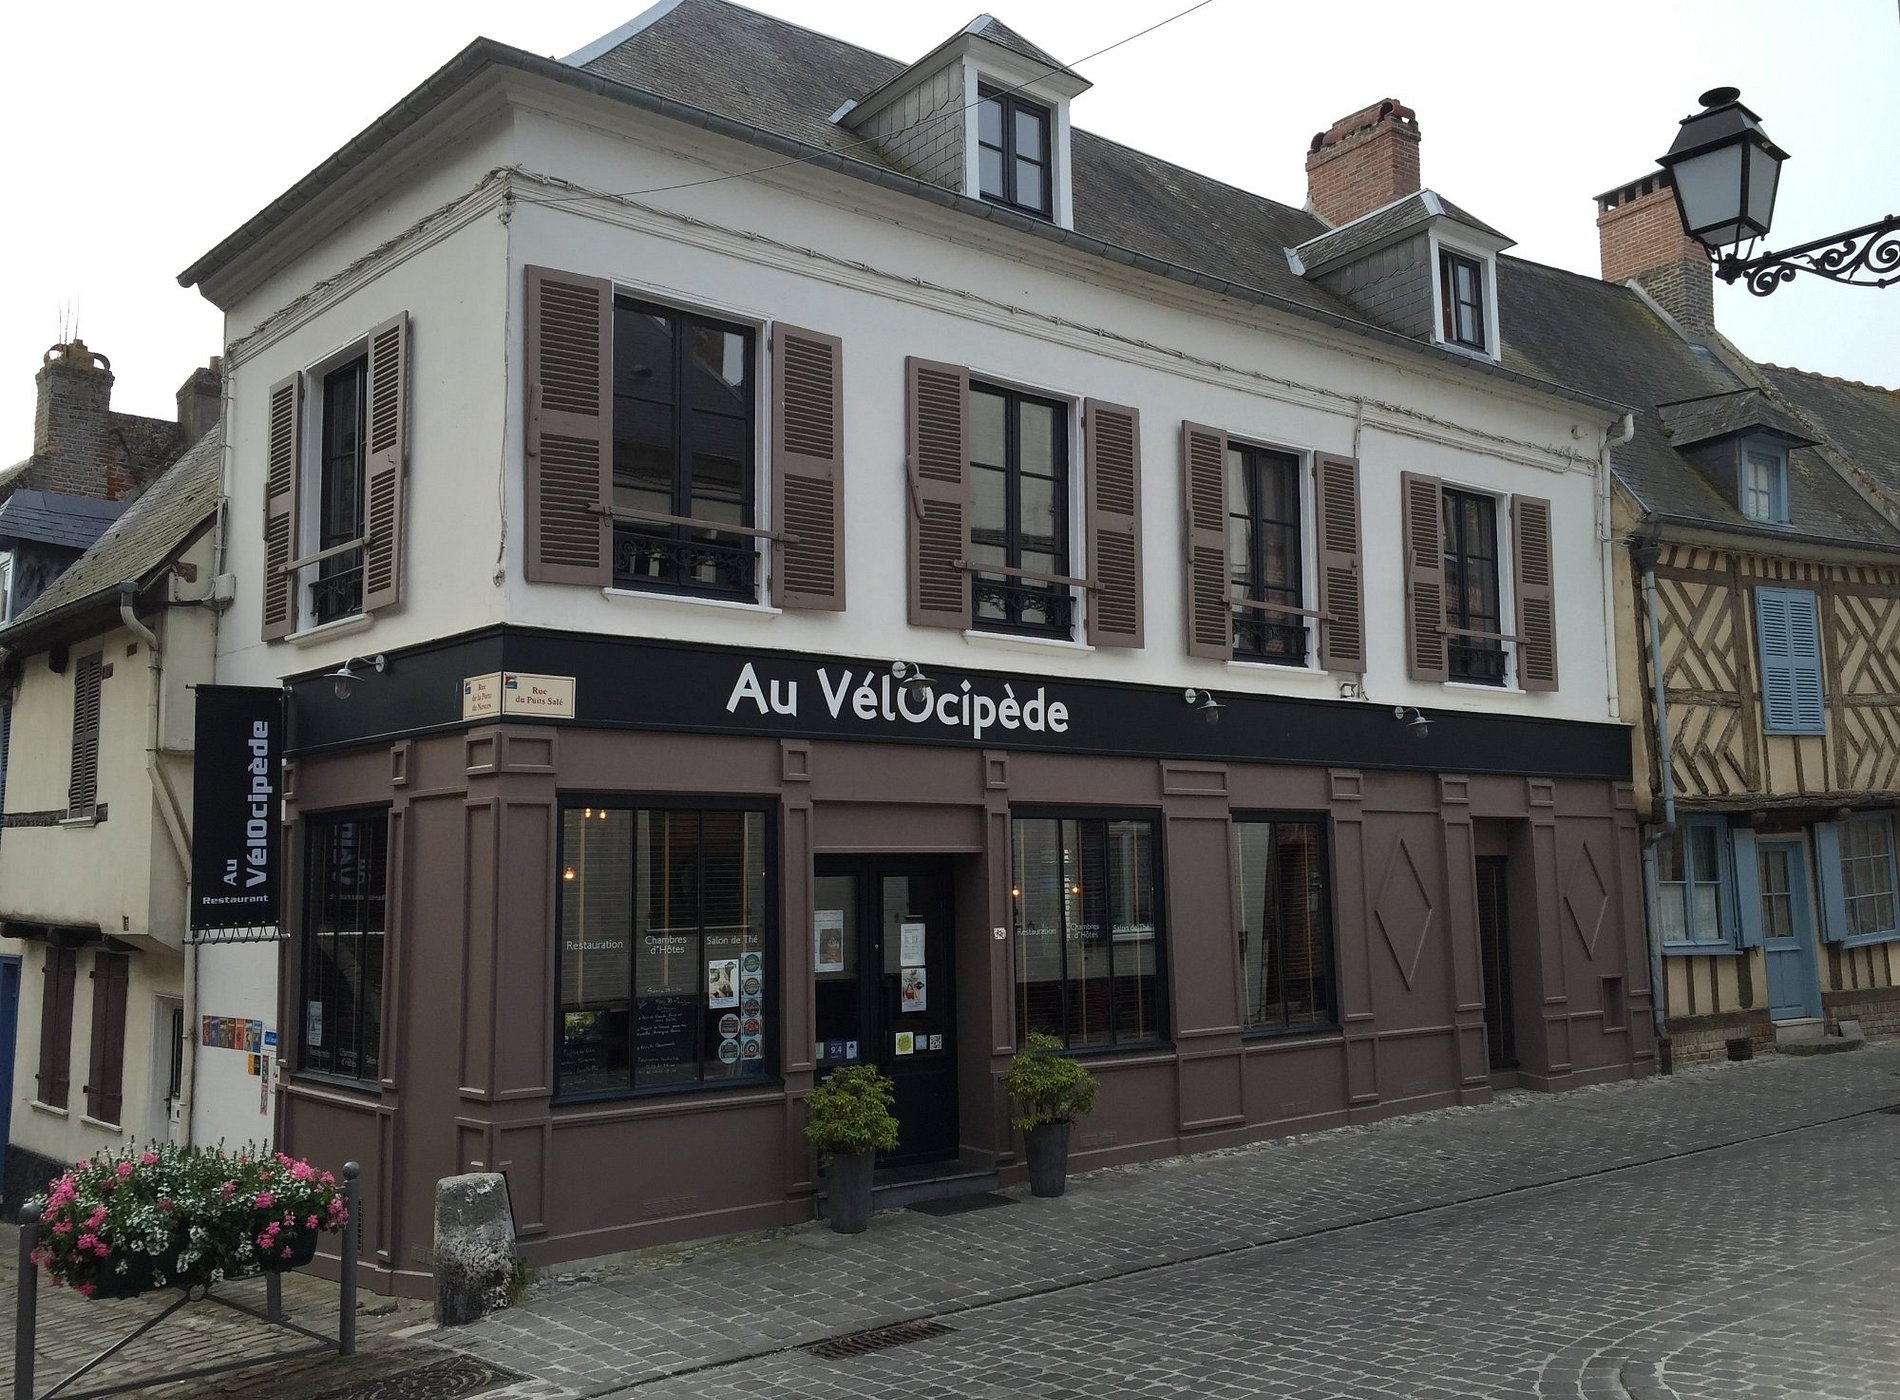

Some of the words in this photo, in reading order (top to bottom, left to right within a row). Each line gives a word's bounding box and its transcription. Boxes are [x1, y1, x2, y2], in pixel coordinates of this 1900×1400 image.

[532, 686, 548, 695] Rue
[726, 662, 797, 717] Au
[515, 695, 525, 703] du
[527, 696, 545, 705] Puits
[547, 697, 564, 706] Salé
[223, 859, 238, 886] Au
[202, 895, 269, 905] Restaurant
[645, 935, 687, 944] Chambres
[706, 936, 728, 945] Salon
[731, 935, 740, 944] de
[743, 935, 758, 944] Thé
[566, 939, 623, 951] Restauration
[650, 945, 685, 955] d'Hôtes
